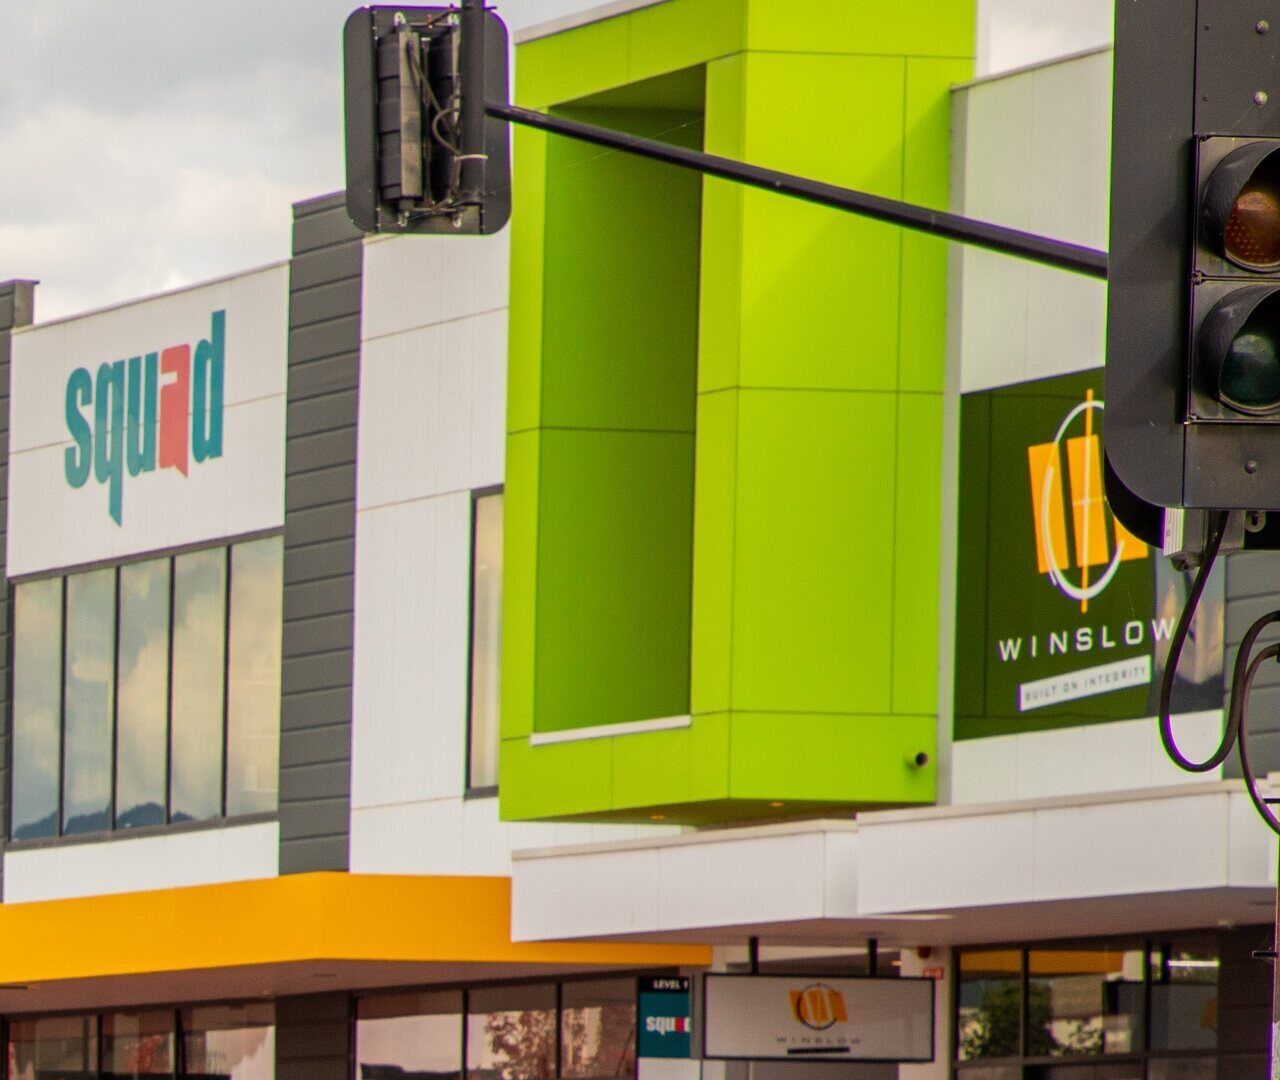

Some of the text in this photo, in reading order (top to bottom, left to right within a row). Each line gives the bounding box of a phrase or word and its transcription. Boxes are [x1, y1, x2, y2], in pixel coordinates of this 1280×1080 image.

[64, 308, 227, 528] squad
[998, 617, 1176, 662] WINSLOW
[1024, 665, 1146, 702] BUILT ON INTEGRITY
[653, 979, 681, 990] LEVEL
